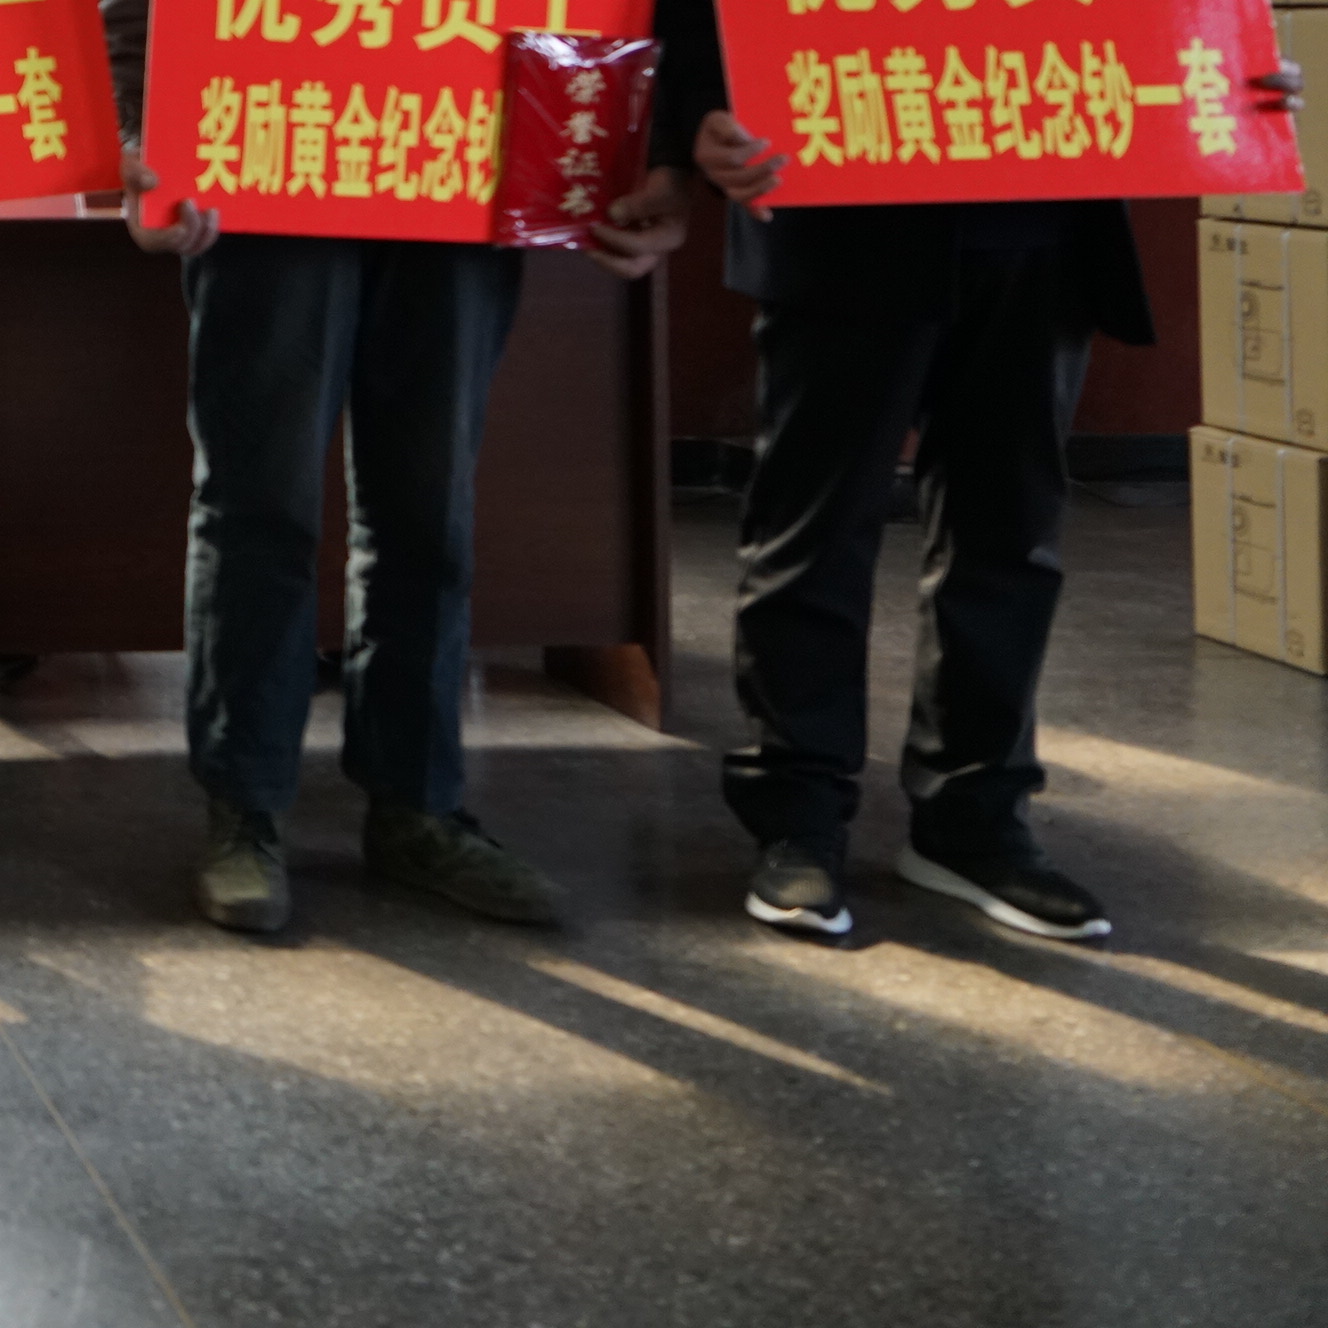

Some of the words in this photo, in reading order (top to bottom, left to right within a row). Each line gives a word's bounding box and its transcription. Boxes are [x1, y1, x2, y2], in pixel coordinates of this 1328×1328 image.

[555, 69, 609, 217] 荣誉证书
[786, 38, 1237, 166] 奖励黄金纪念钞一套
